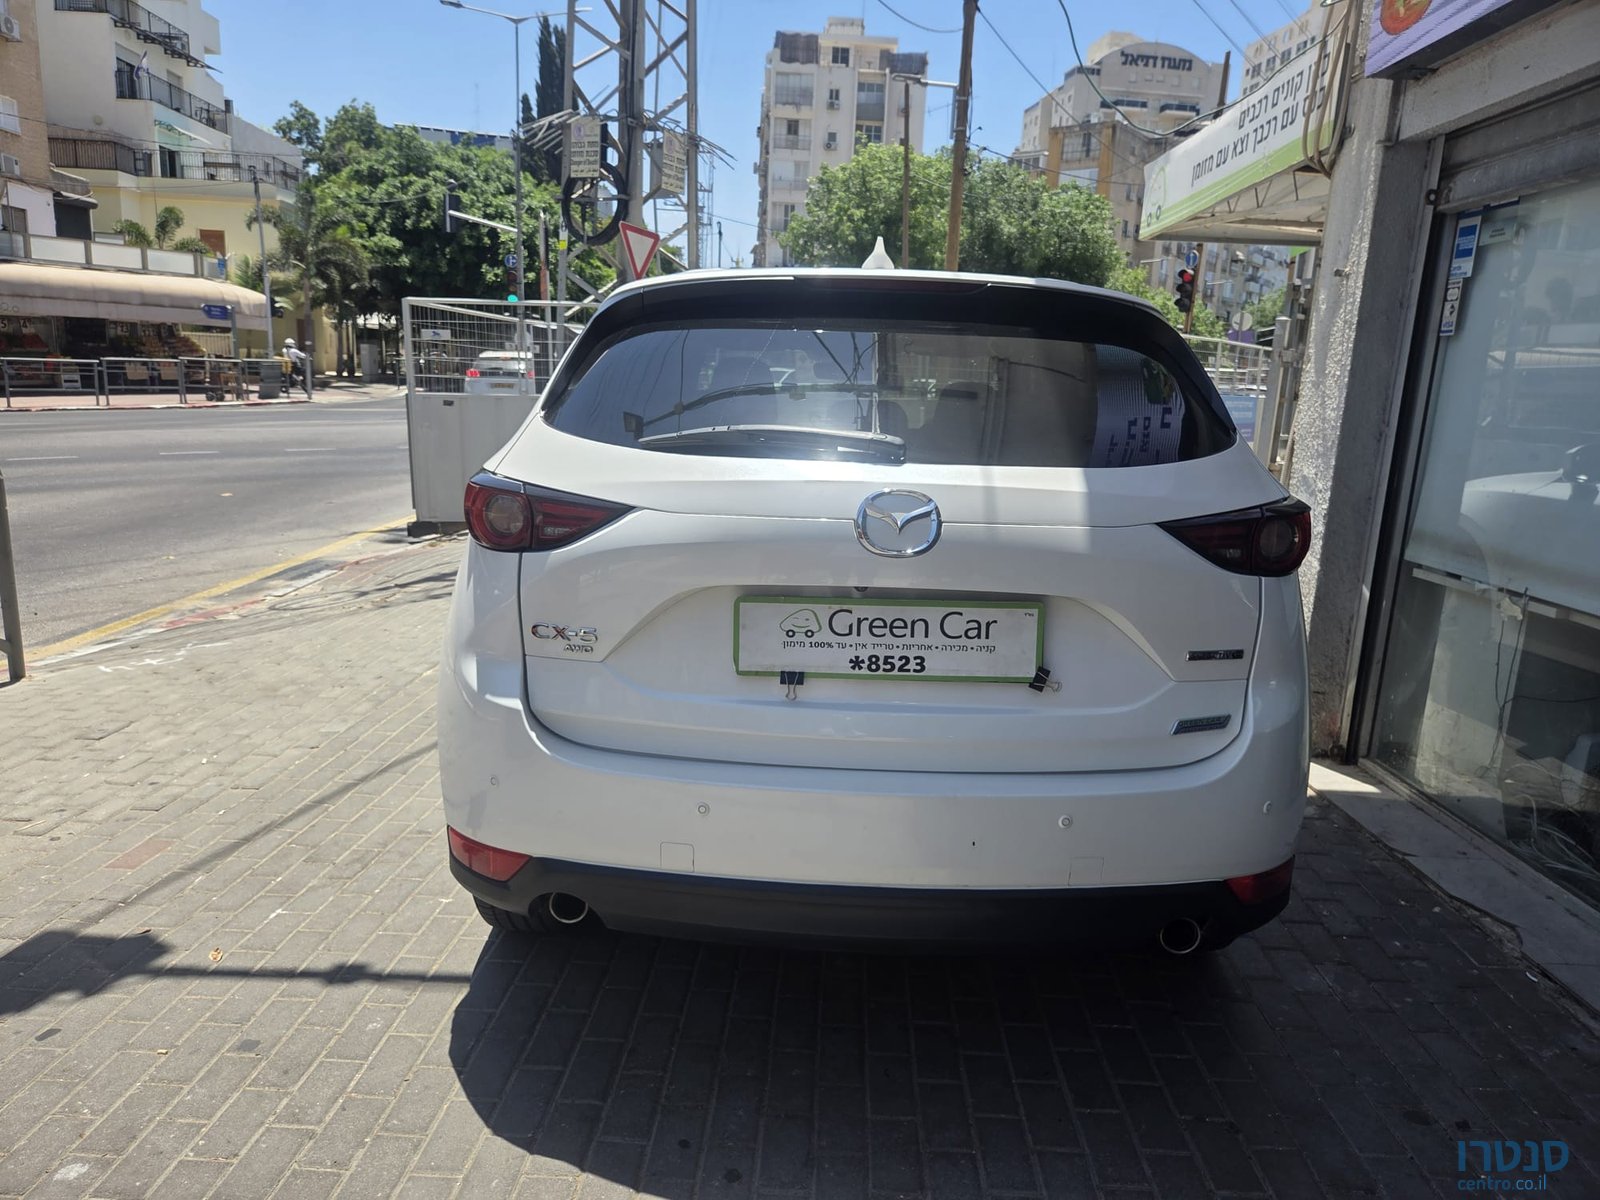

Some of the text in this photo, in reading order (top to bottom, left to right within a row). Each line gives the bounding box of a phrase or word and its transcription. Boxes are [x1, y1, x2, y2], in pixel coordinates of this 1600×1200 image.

[1120, 50, 1193, 71] מעוז דניאל
[1272, 69, 1304, 109] קונים
[1238, 94, 1268, 130] רכבים
[1281, 101, 1299, 131] עם
[1253, 116, 1277, 153] רכבך
[1216, 145, 1230, 168] עם
[1231, 132, 1250, 160] וצא
[1191, 154, 1214, 187] מזומן
[531, 622, 598, 644] CX-5
[828, 609, 998, 640] Green Car
[783, 640, 806, 649] מימון
[809, 641, 834, 649] 100%
[855, 642, 868, 651] אין
[902, 643, 933, 651] אחריות
[941, 644, 968, 652] מכירה
[976, 644, 996, 654] קניה
